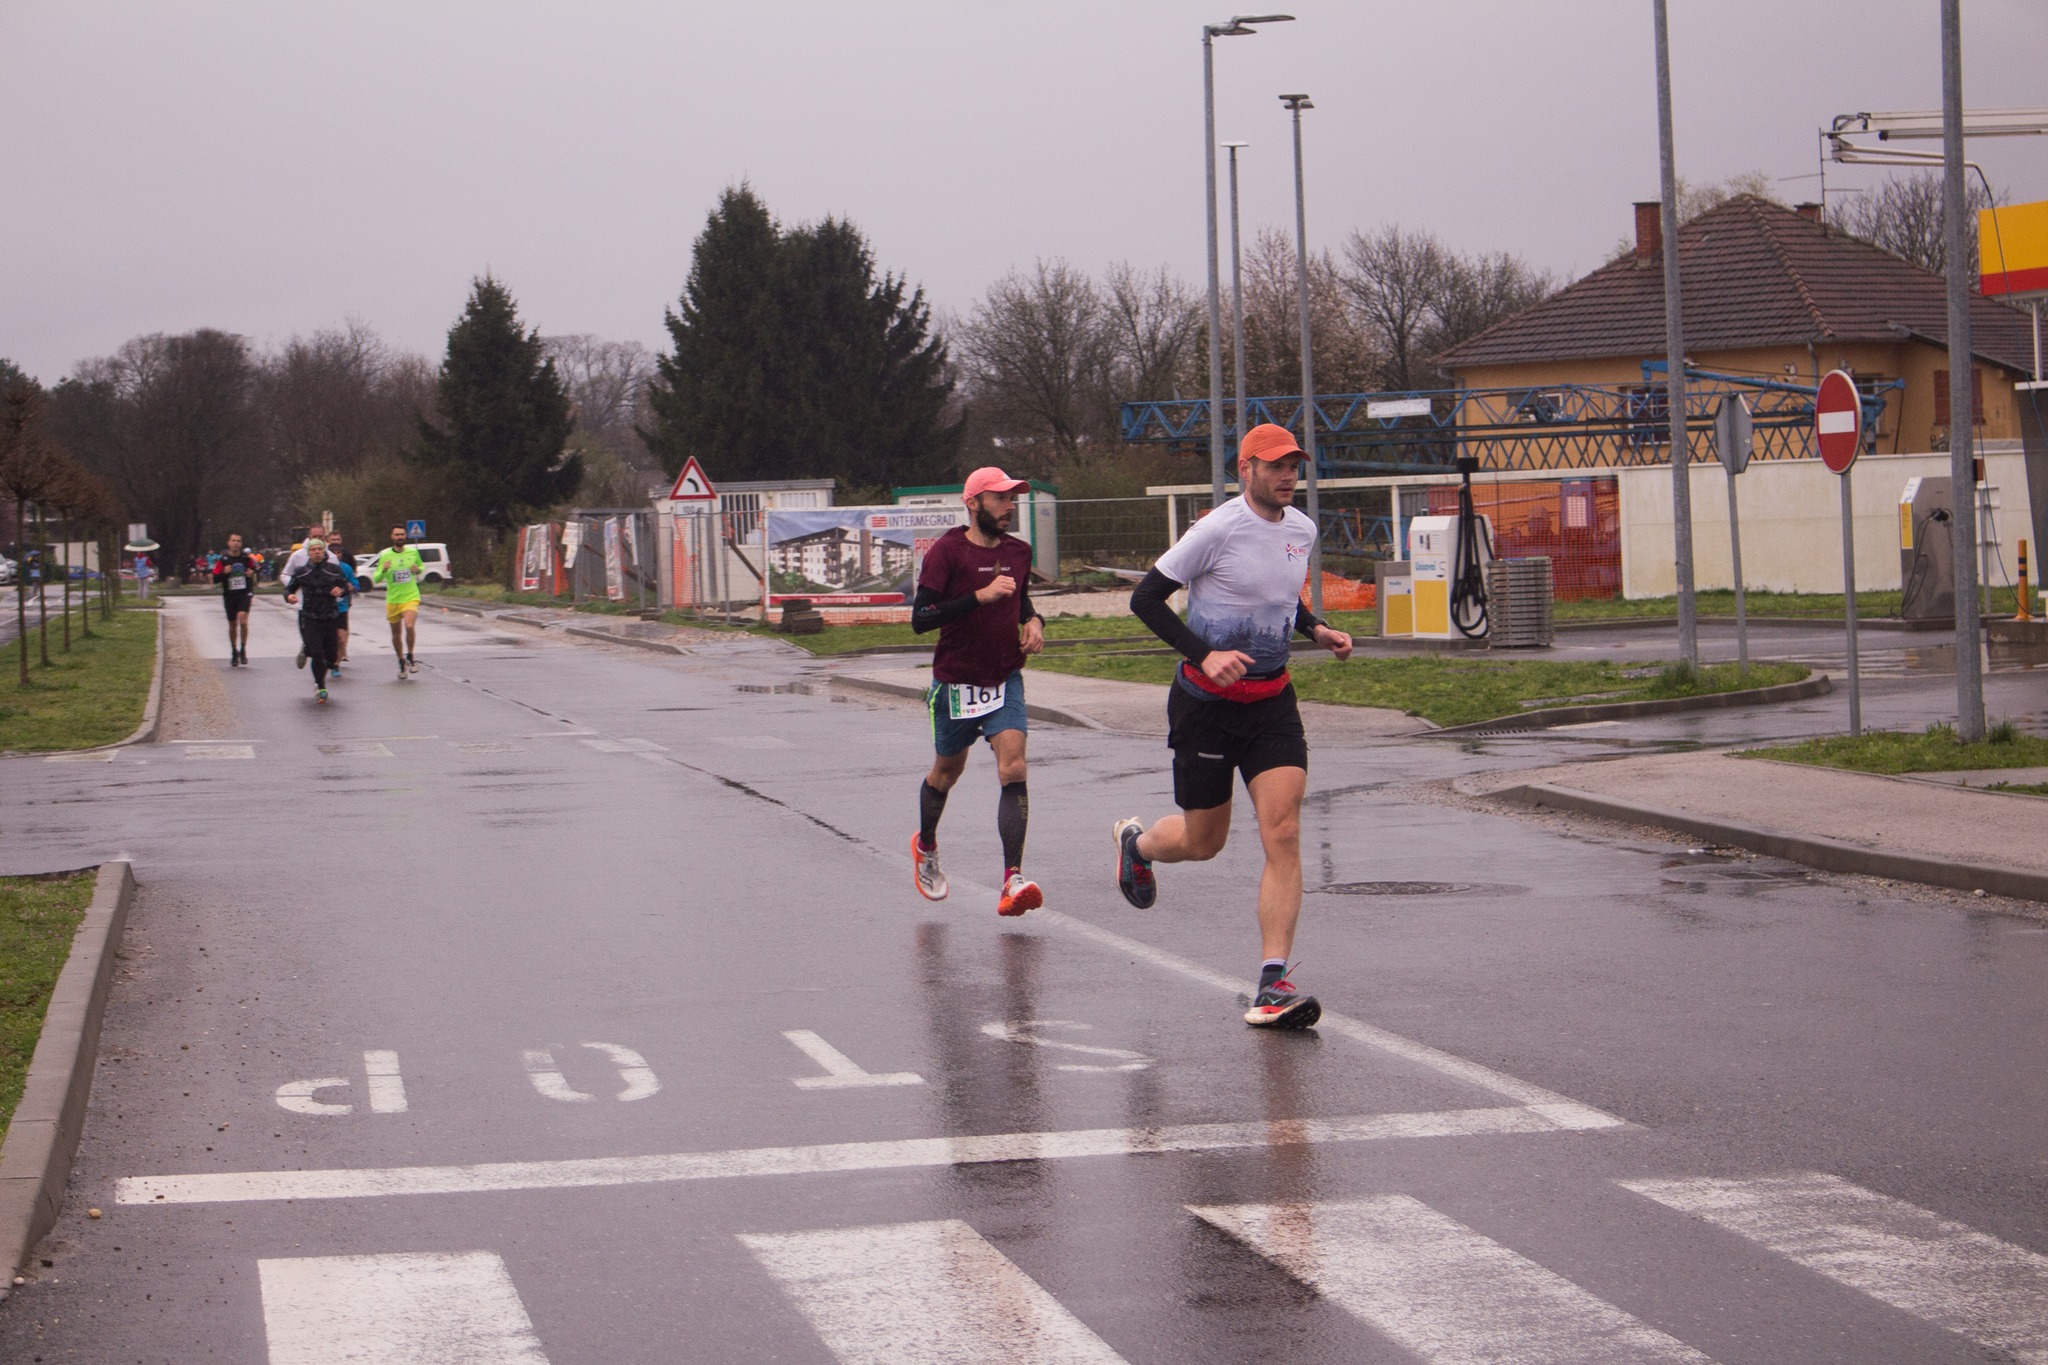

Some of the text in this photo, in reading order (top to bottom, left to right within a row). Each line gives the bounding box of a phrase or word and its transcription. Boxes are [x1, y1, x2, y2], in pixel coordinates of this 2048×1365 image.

[889, 514, 956, 528] INTERMEGRAD
[914, 537, 937, 558] PR
[397, 571, 410, 579] 225
[966, 685, 1002, 706] 161
[276, 1020, 1156, 1115] STOP
